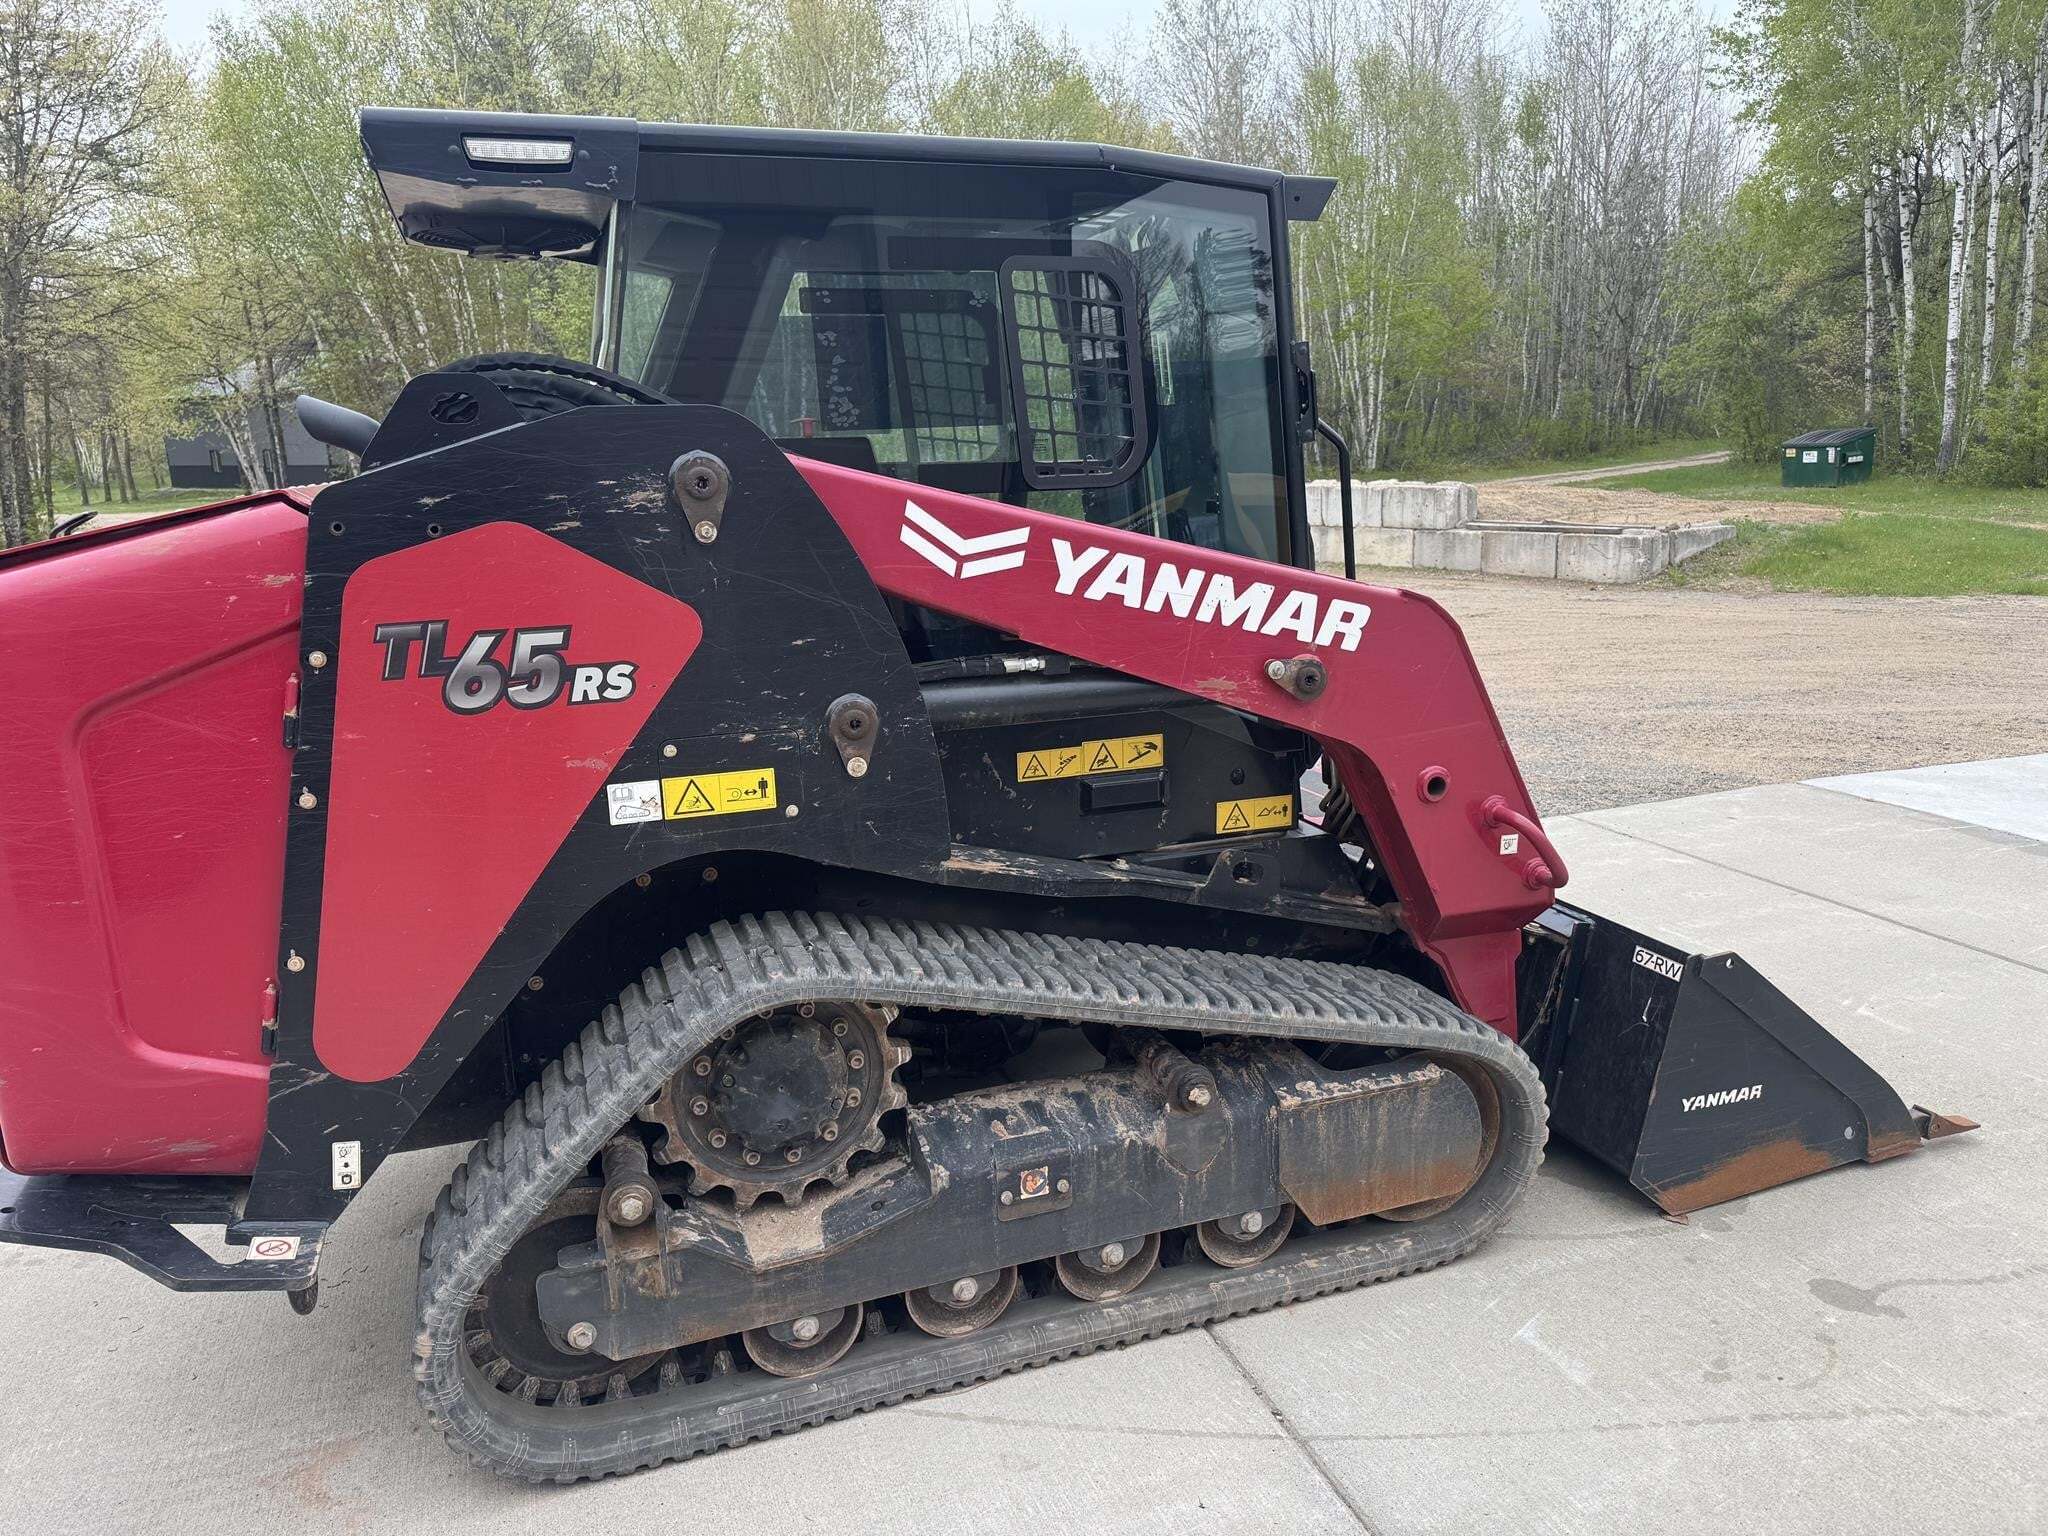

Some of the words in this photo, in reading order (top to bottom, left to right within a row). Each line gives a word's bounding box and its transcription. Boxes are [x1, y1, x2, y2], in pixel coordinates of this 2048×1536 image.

[1051, 538, 1372, 652] YANMAR
[1635, 949, 1681, 978] 67-RW
[1682, 1084, 1762, 1112] YANMAR
